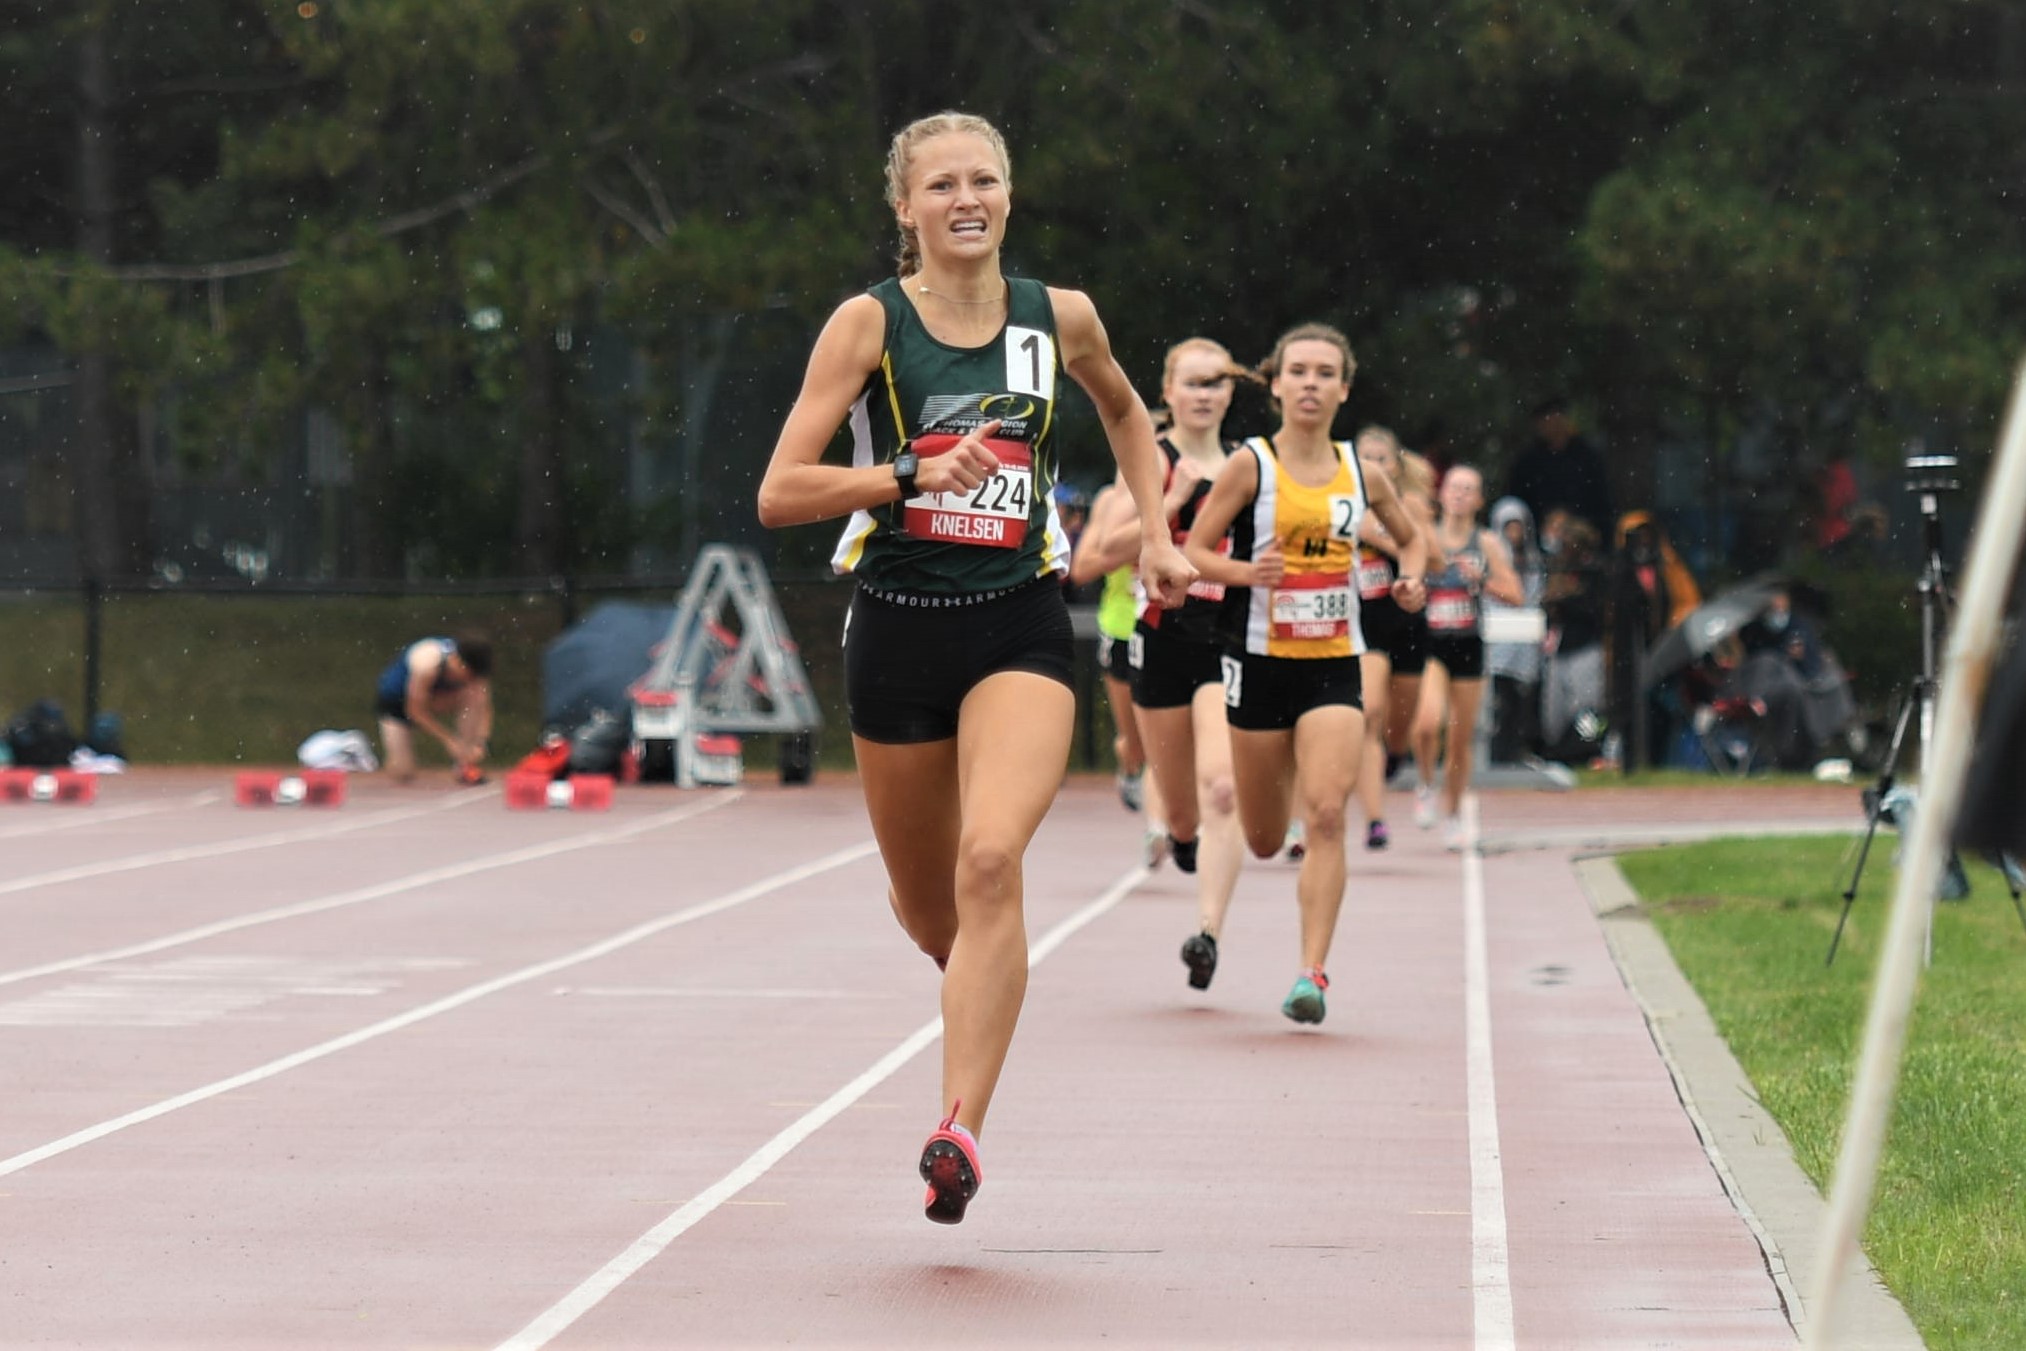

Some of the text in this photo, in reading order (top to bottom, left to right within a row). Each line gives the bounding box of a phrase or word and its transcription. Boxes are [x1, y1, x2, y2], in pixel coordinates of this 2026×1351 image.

[1020, 334, 1040, 392] 1
[970, 474, 1026, 514] 224
[931, 513, 1004, 541] KNELSEN
[1336, 499, 1352, 538] 2
[875, 590, 940, 608] ARMOUR
